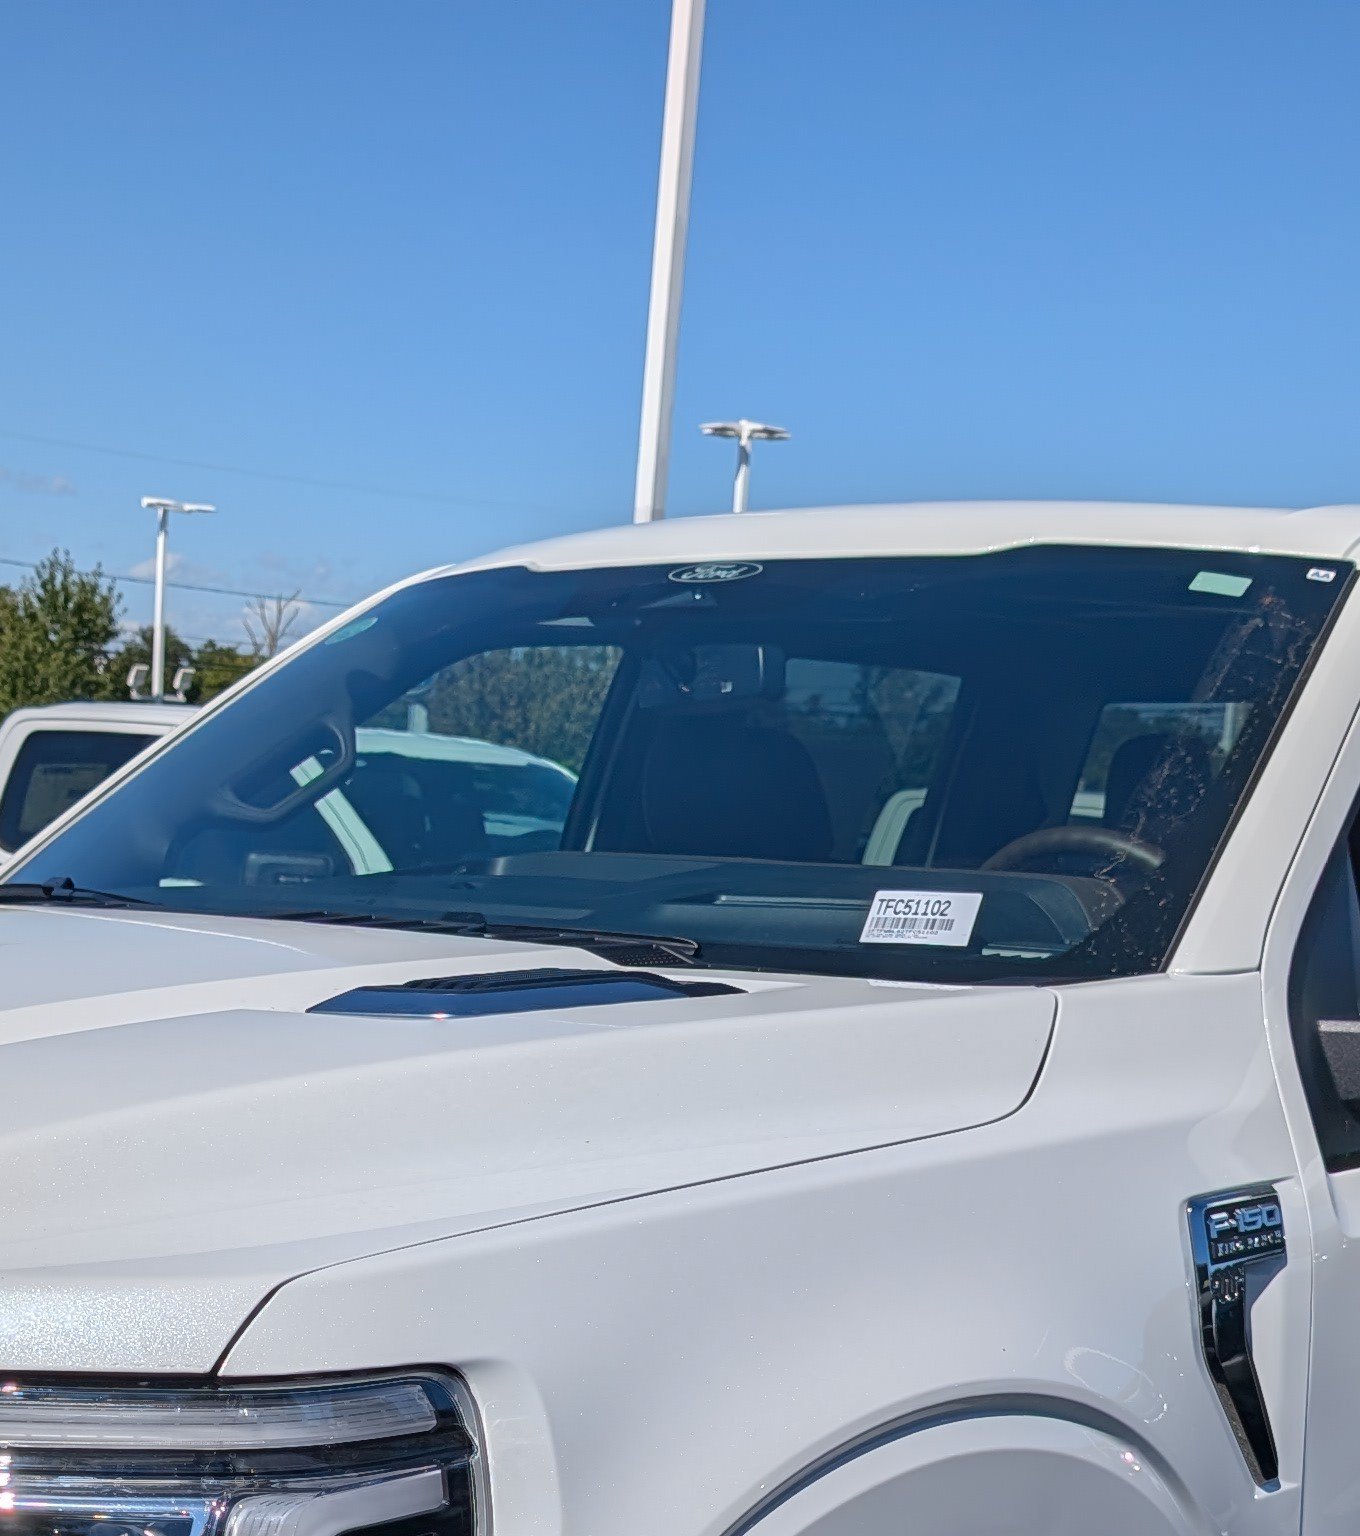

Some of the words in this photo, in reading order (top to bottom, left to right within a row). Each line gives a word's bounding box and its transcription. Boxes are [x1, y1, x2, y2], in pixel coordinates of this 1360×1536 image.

[681, 563, 748, 579] Ford
[876, 898, 952, 917] TFC51102
[1207, 1204, 1281, 1239] F-150
